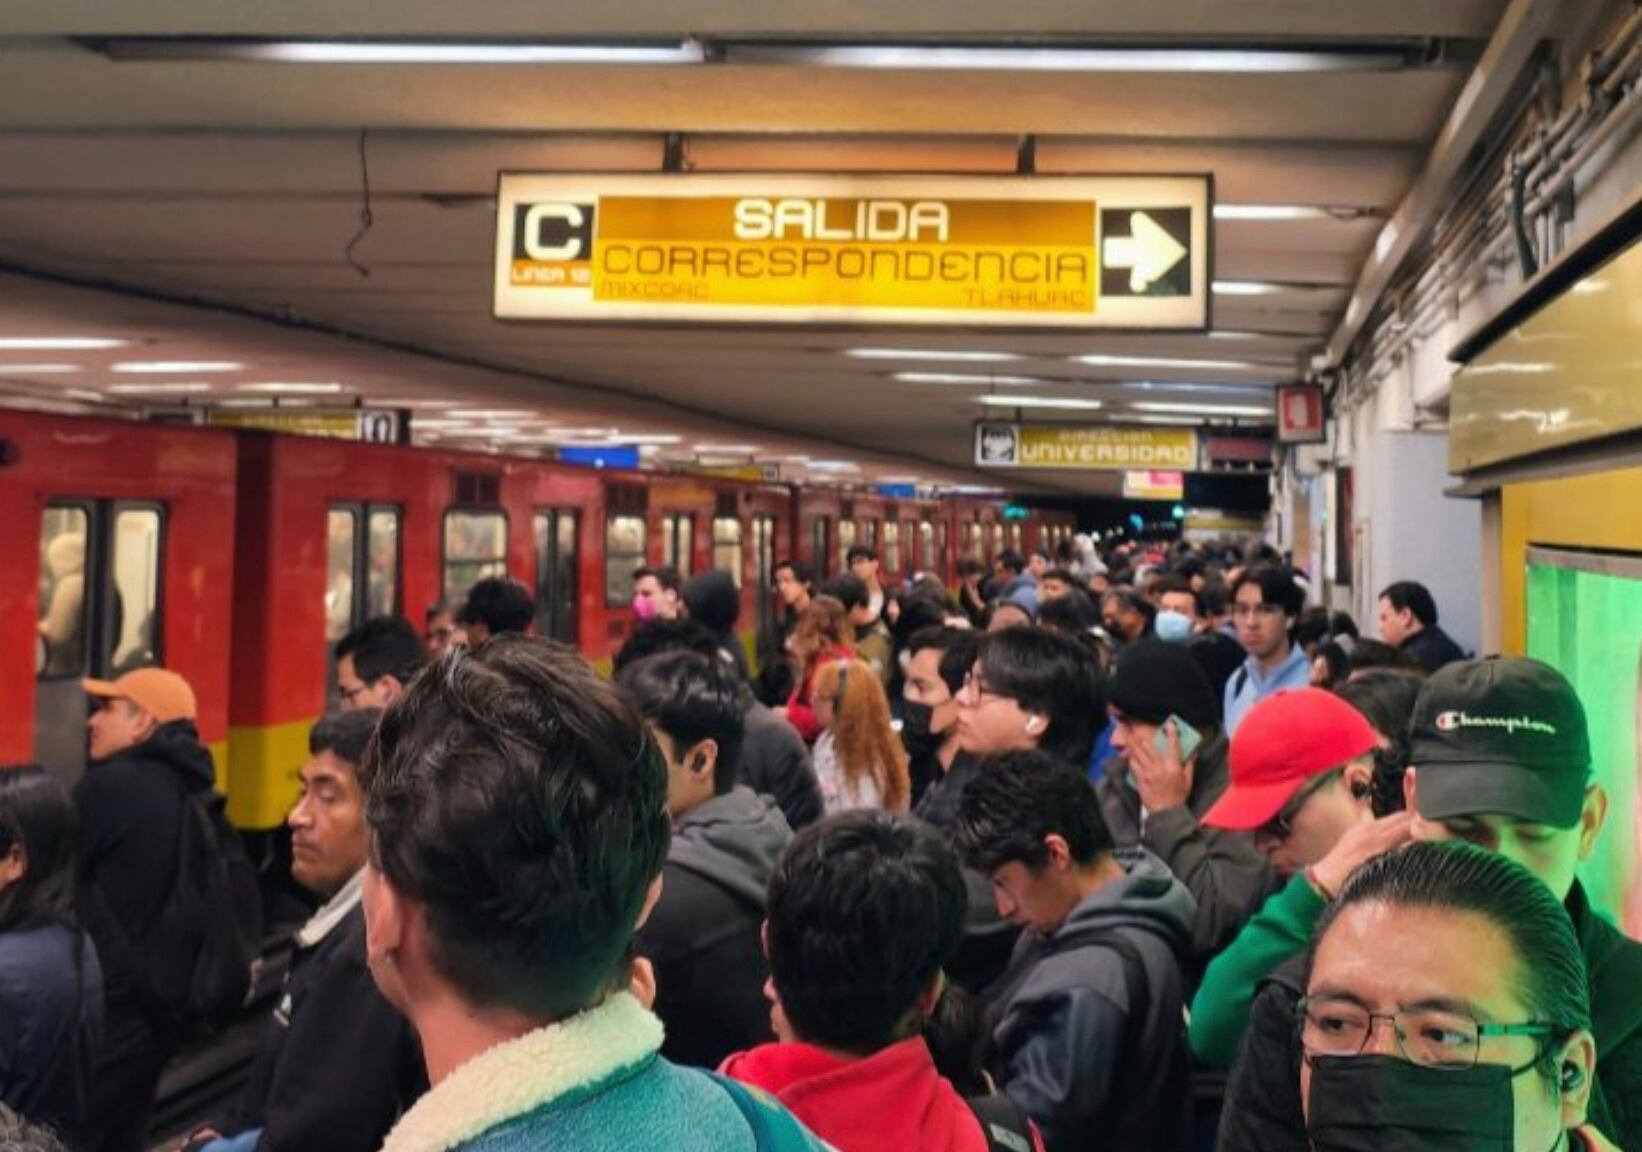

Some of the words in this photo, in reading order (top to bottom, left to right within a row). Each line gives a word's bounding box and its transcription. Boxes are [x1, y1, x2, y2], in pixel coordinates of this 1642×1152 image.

[734, 199, 948, 241] SALIDA
[524, 204, 583, 261] C
[602, 245, 1087, 284] CORRESPONDENCIA
[601, 281, 708, 299] MIXCOAC
[966, 288, 1085, 307] TLAHUAC
[1021, 443, 1189, 463] UNIVERSIDAD
[1435, 710, 1556, 734] Champion
